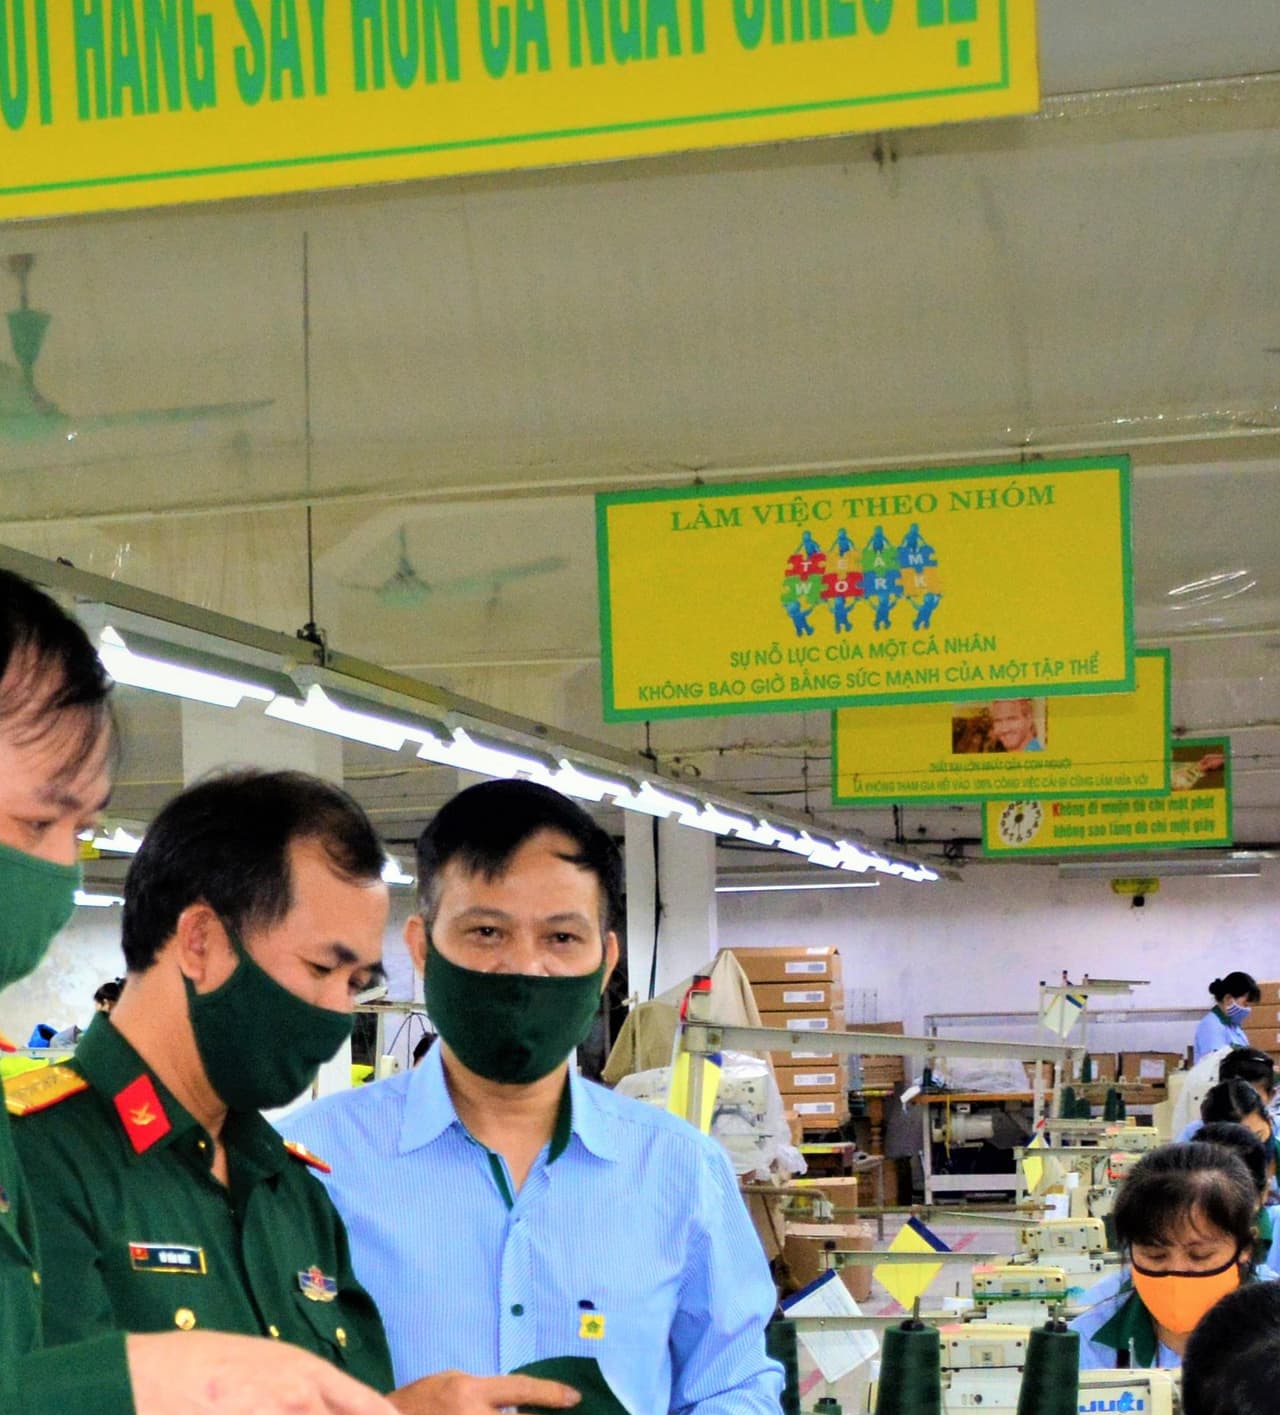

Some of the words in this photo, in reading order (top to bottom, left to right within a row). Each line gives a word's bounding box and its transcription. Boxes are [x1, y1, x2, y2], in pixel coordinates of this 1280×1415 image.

[670, 503, 742, 532] LÀM
[752, 495, 833, 529] VIỆC
[843, 493, 939, 520] THEO
[949, 480, 1057, 512] NHÓM
[754, 641, 783, 666] NỖ
[825, 640, 864, 662] CỦA
[869, 638, 908, 661] MỘT
[912, 634, 939, 656] CÁ
[943, 633, 997, 655] NHÂN
[638, 681, 704, 701] KHÔNG
[708, 680, 746, 698] BAO
[750, 672, 785, 694] GIỜ
[790, 669, 841, 692] BẰNG
[846, 667, 881, 688] SỨC
[886, 668, 940, 689] MẠNH
[945, 660, 984, 683] CỦA
[989, 659, 1028, 683] MỘT
[1032, 657, 1065, 680] TẬP
[1070, 650, 1100, 675] THỂ
